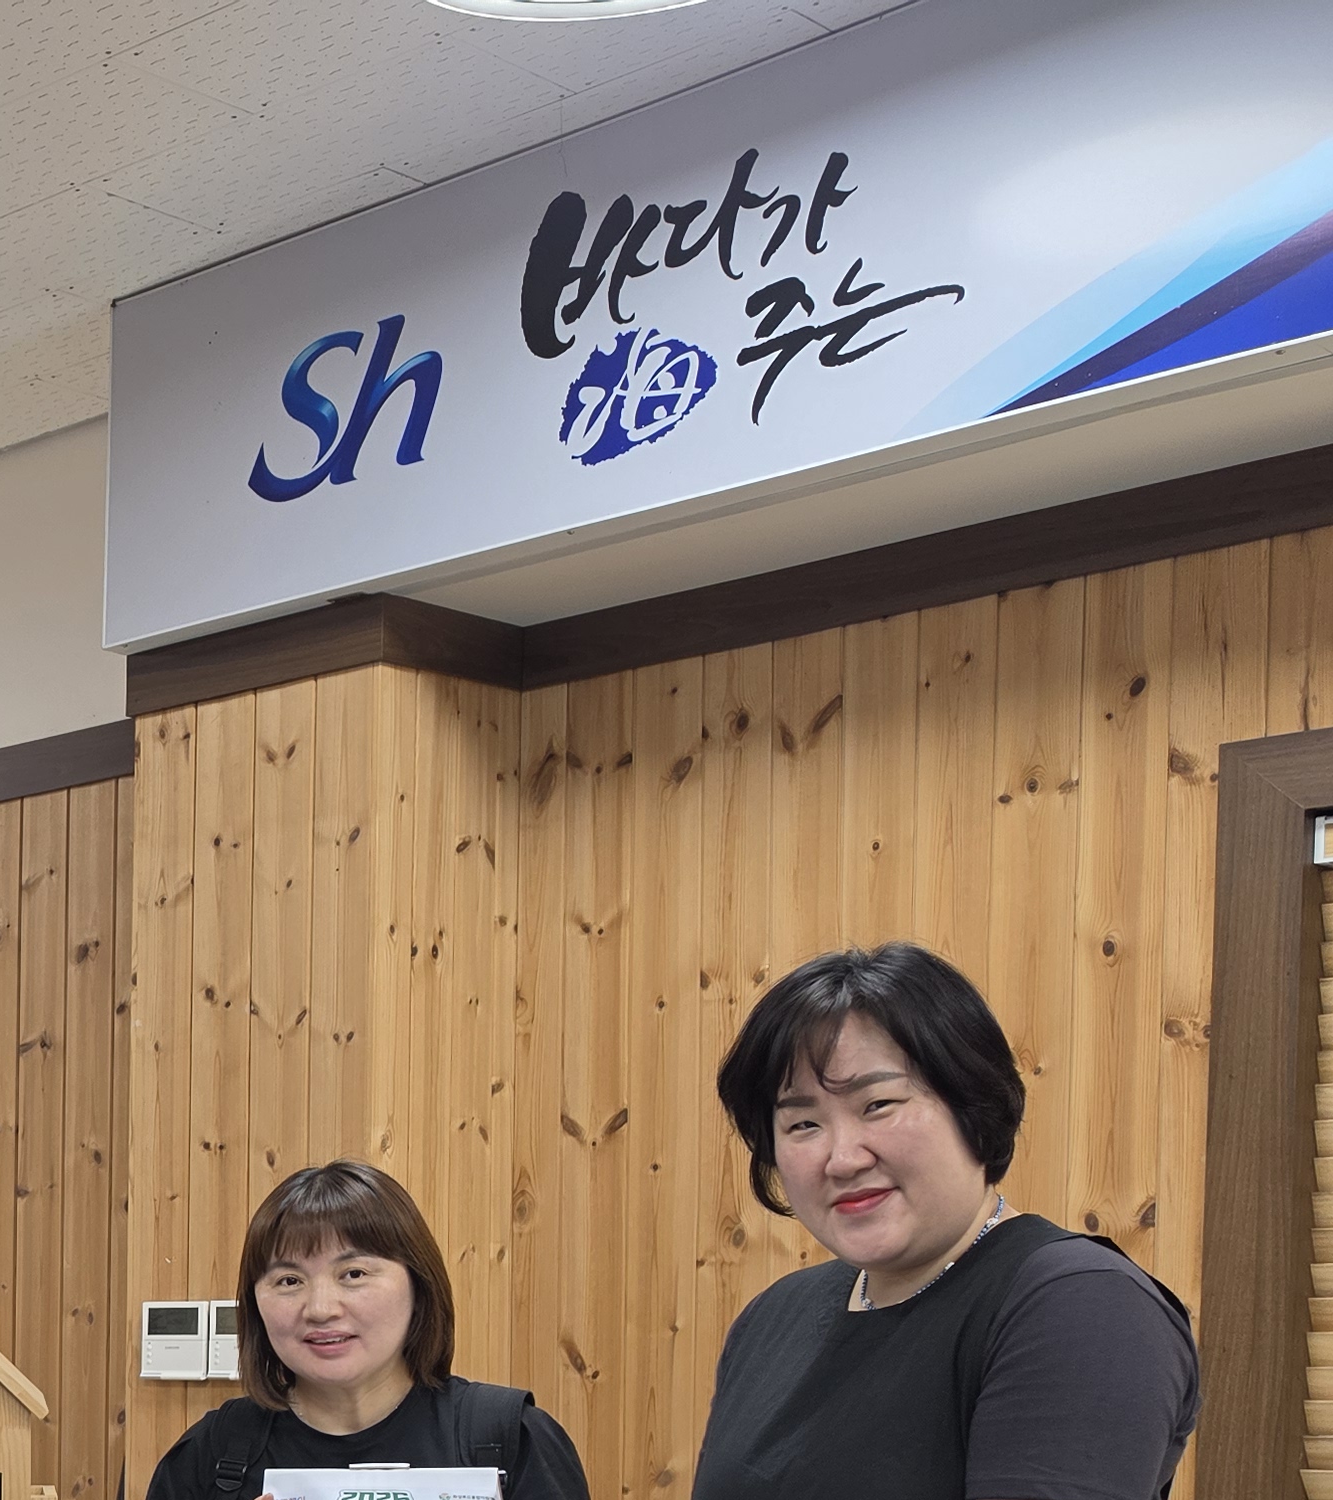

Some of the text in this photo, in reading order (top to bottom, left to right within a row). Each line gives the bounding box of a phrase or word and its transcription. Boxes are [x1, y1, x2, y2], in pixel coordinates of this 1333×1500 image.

[520, 148, 858, 359] 바다가
[738, 258, 965, 425] 주는
[247, 314, 443, 503] Sh
